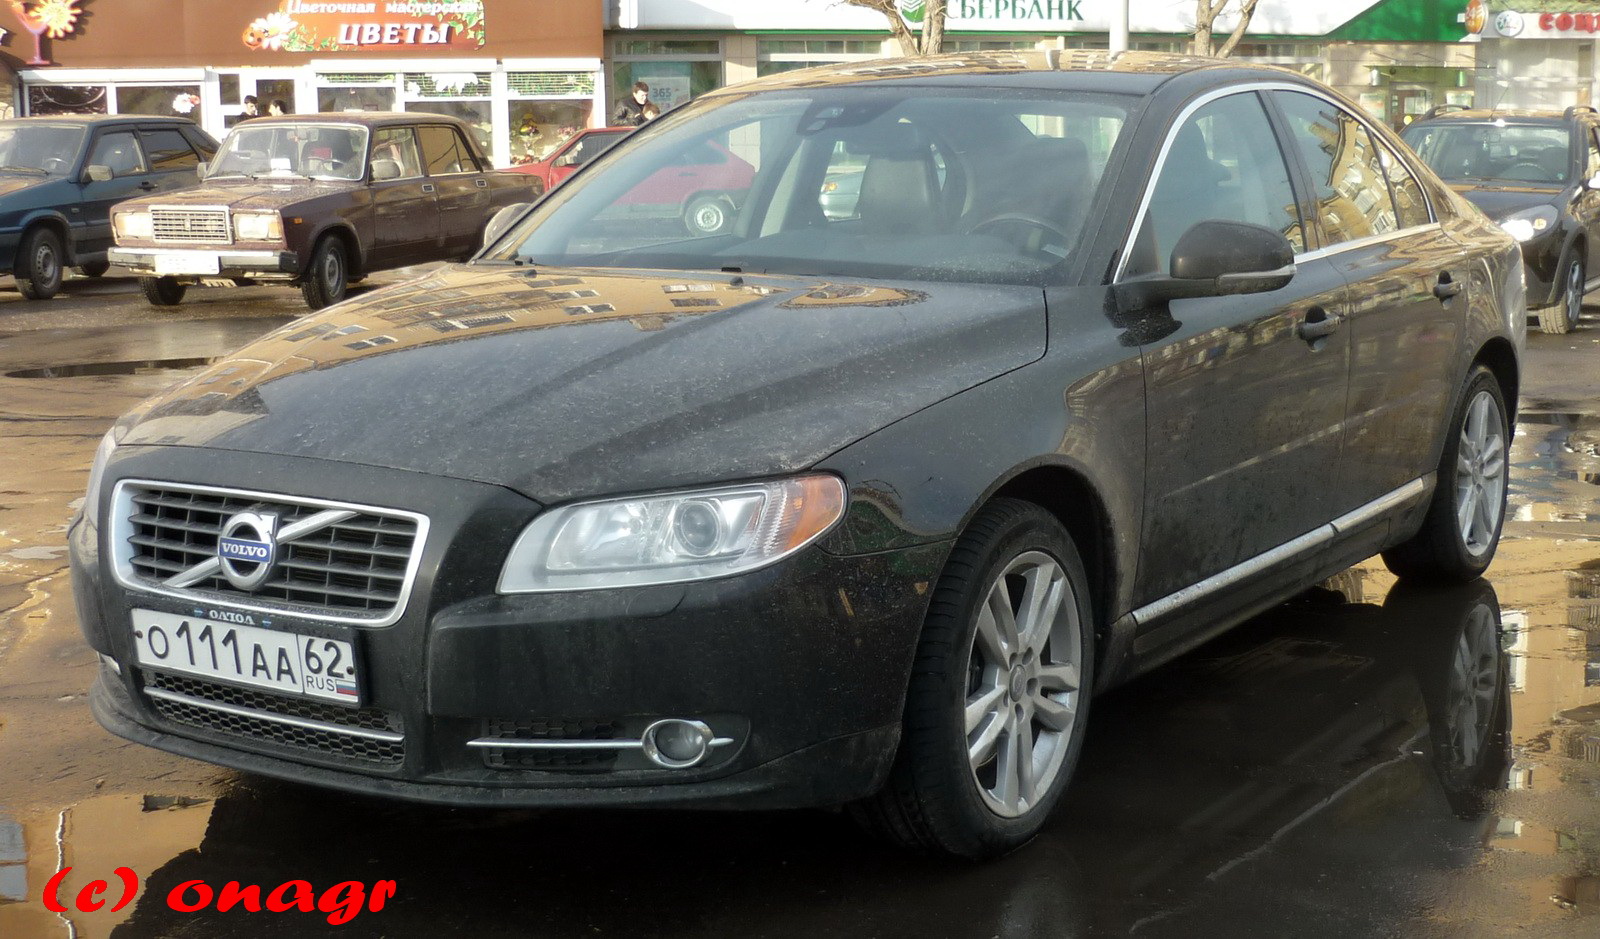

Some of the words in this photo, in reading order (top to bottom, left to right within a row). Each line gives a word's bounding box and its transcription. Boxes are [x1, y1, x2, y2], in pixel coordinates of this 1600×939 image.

[286, 0, 376, 14] Цветочная
[338, 23, 451, 46] ЦВЕТЫ
[652, 87, 672, 98] 365
[221, 542, 268, 558] VOLVO
[208, 609, 256, 625] VOLVO
[305, 638, 345, 679] 62
[305, 675, 336, 692] RUS
